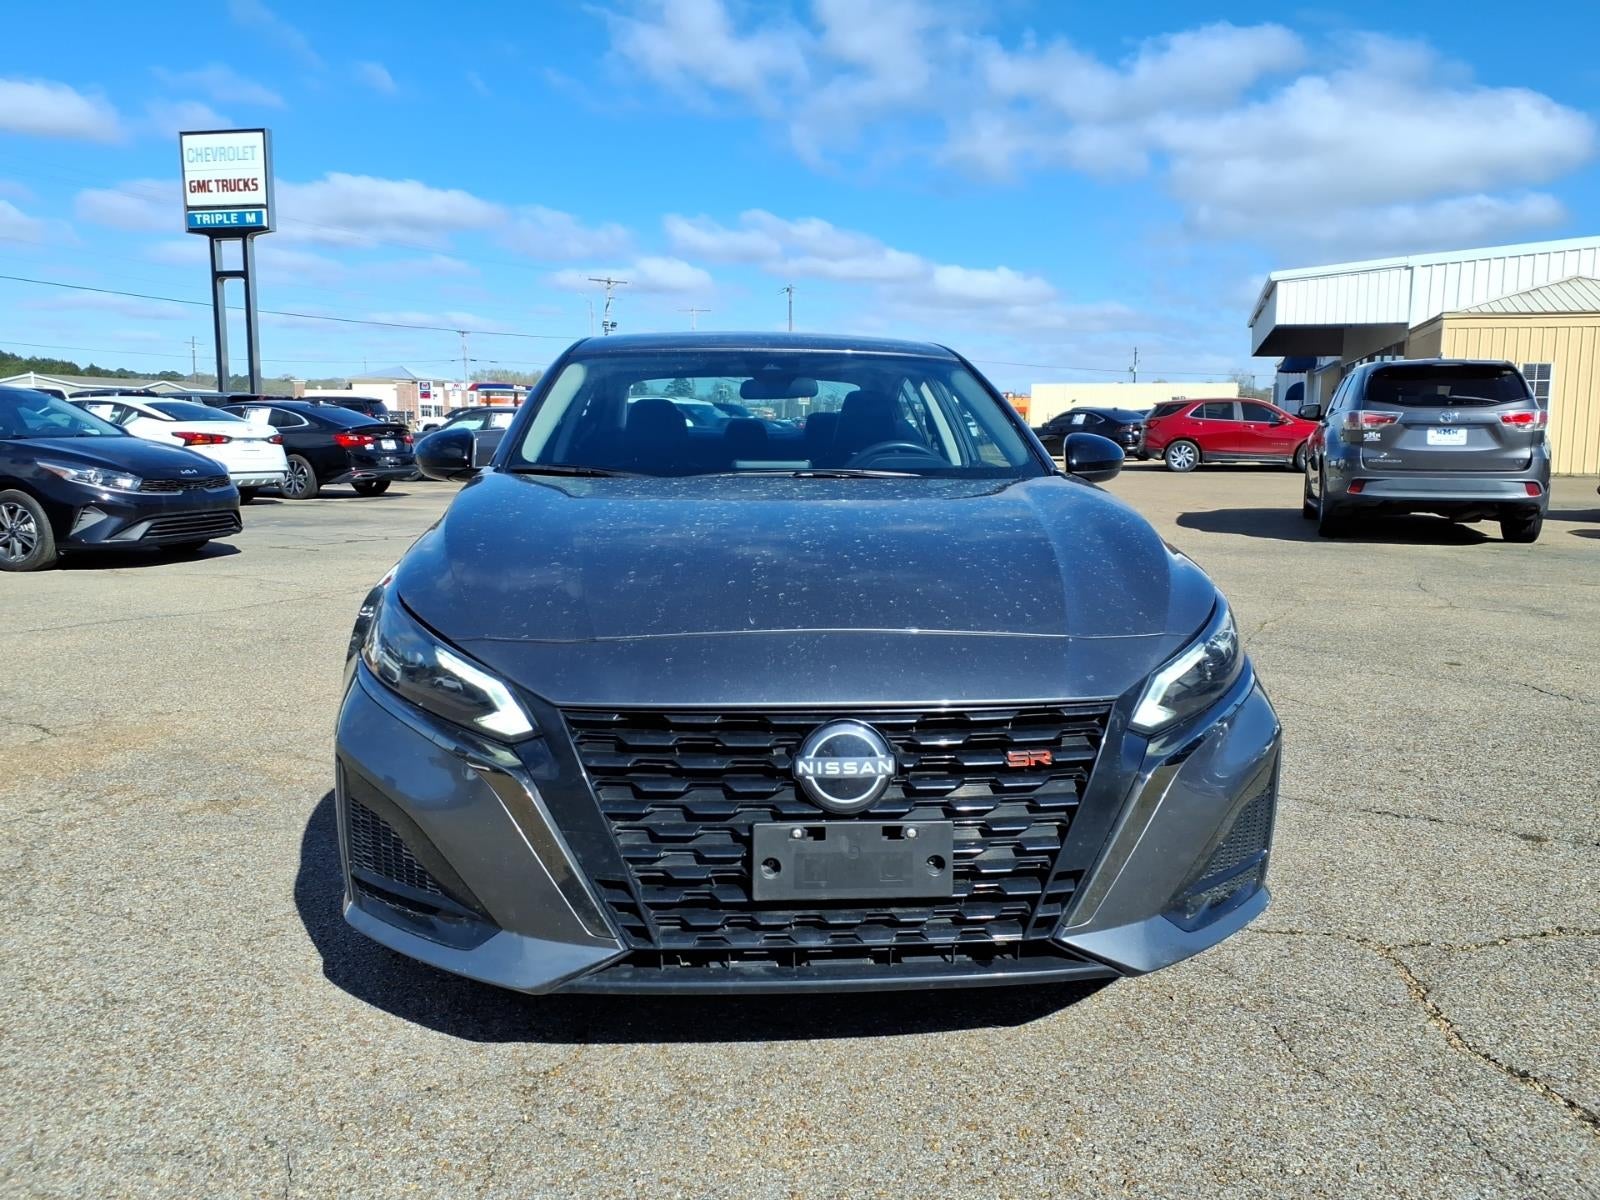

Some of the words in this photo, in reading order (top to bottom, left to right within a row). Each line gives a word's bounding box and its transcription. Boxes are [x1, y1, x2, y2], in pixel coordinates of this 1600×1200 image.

[186, 145, 257, 163] CHEVROLET
[189, 179, 213, 193] GMC
[214, 177, 259, 193] TRUCKS
[194, 213, 239, 225] TRIPLE
[245, 213, 256, 223] M
[1007, 749, 1053, 767] SR
[797, 759, 894, 776] NISSAN
